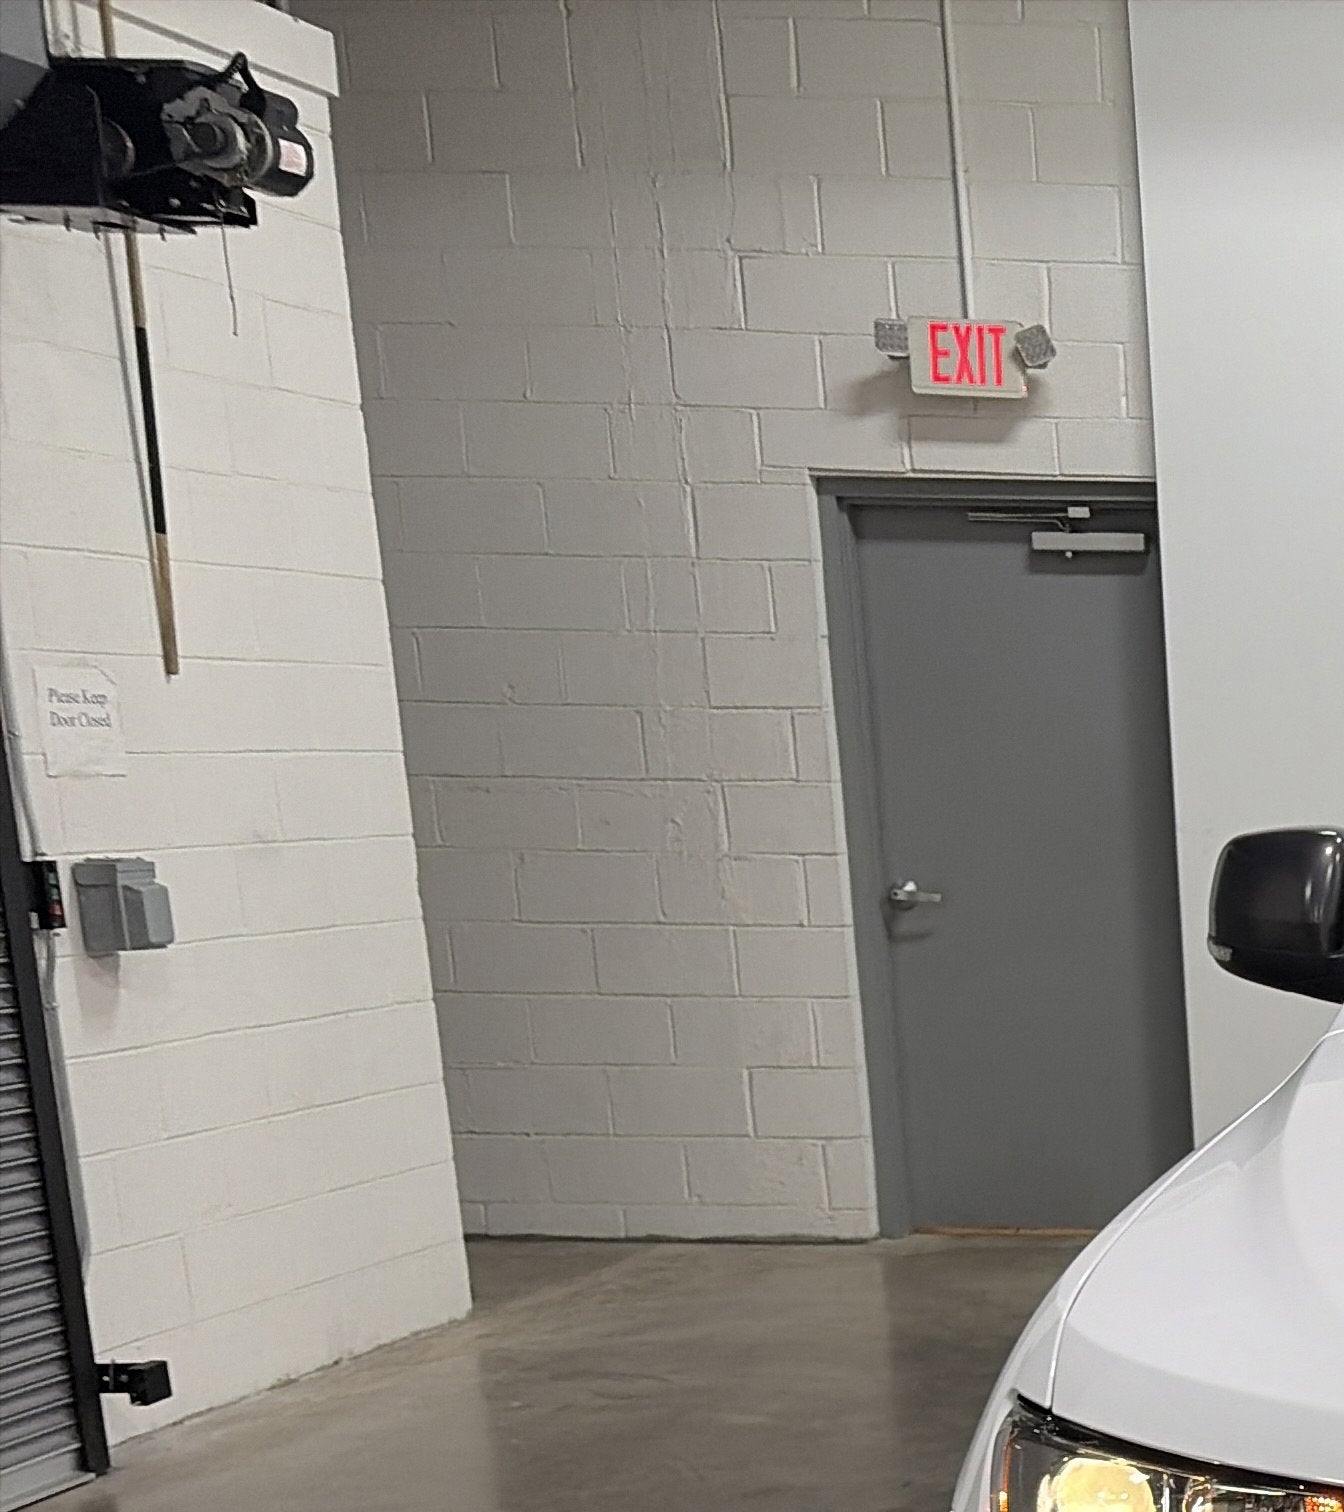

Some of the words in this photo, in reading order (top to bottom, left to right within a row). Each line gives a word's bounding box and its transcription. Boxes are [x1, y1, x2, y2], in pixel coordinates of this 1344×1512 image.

[928, 320, 1006, 386] EXIT
[47, 687, 80, 704] Please
[80, 688, 108, 709] Keep
[49, 710, 77, 728] Door
[77, 711, 112, 728] Closed
